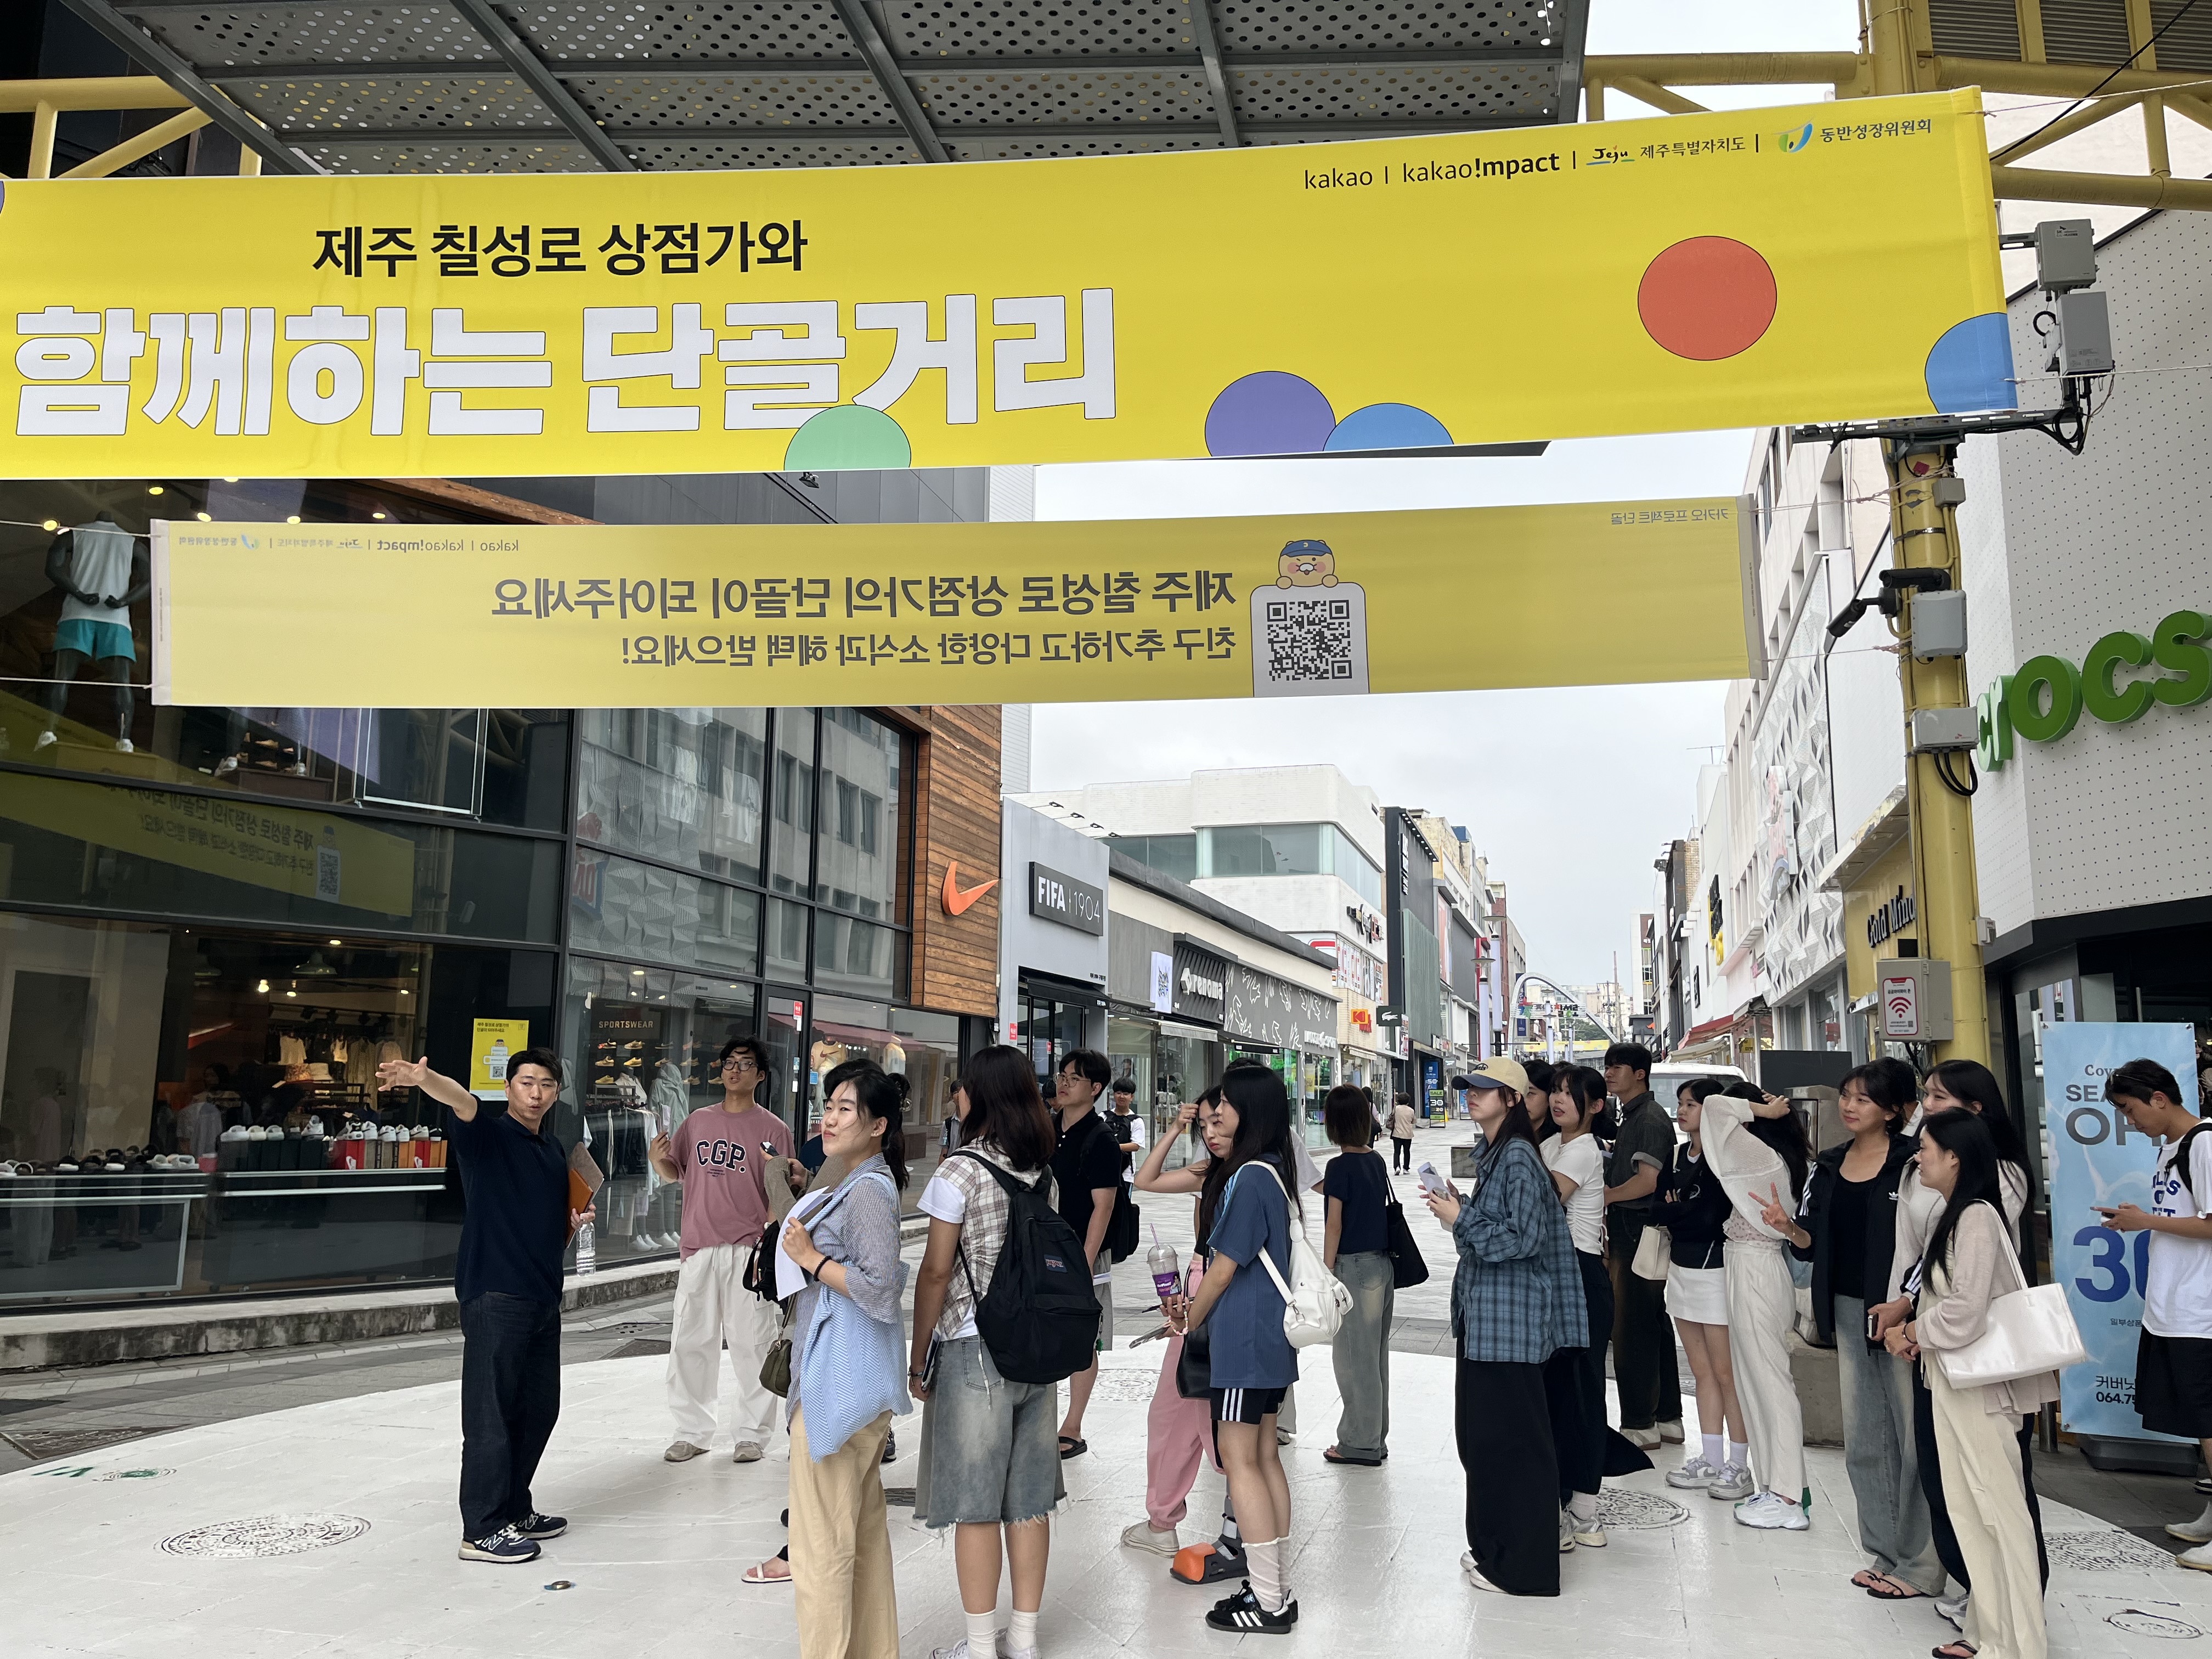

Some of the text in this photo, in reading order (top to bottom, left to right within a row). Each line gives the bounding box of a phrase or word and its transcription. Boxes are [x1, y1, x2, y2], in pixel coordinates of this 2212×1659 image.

[1819, 118, 1932, 143] 동반성장위원회
[1591, 145, 1630, 165] Jeju
[1639, 136, 1746, 160] 제주특별자치도
[1304, 167, 1374, 190] kakao
[1402, 152, 1561, 183] kakao!mpact
[312, 219, 808, 278] 제주 칠성로 상점가와
[15, 287, 1116, 436] 함께하는 단골거리
[1976, 610, 2212, 772] crocs
[1038, 876, 1101, 923] FIFA 1904
[1867, 915, 1890, 949] Gold
[1189, 974, 1223, 1001] renoma
[599, 1020, 653, 1029] SPORTSWEAR
[695, 1138, 747, 1173] CGP.
